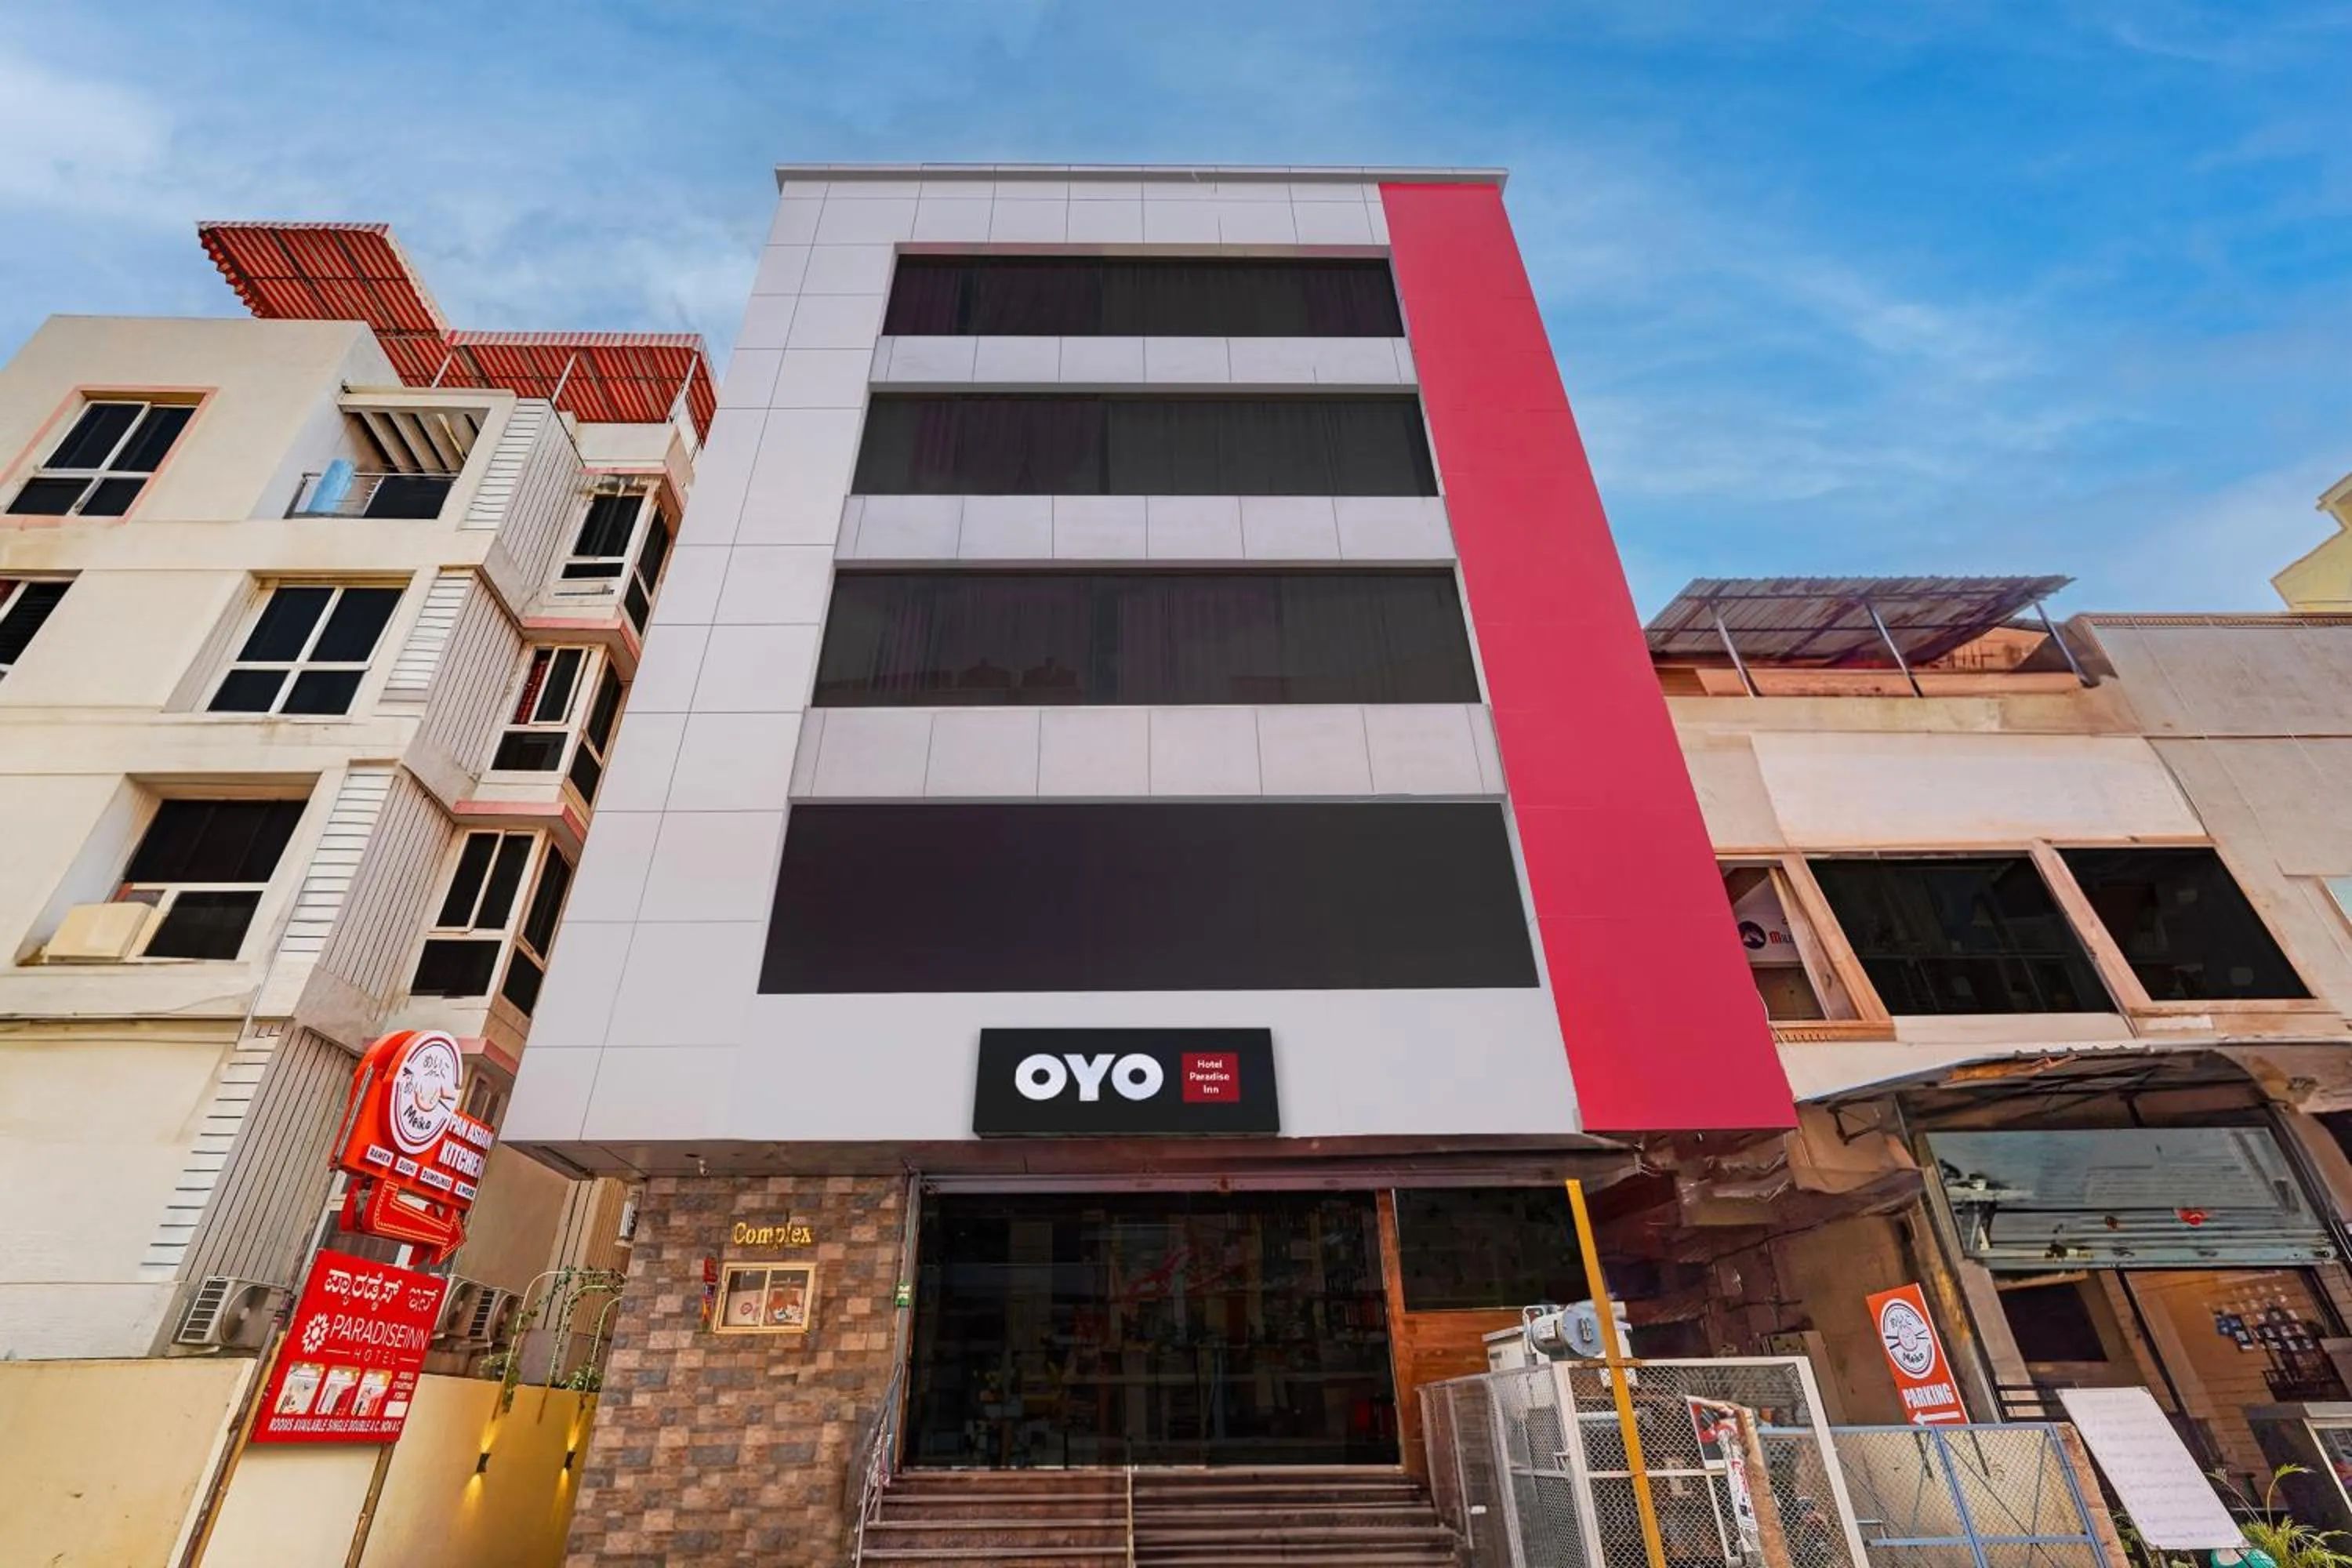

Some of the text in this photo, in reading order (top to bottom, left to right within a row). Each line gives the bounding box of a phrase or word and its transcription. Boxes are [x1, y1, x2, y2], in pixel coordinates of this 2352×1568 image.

[1197, 1059, 1222, 1069] Hotel
[1014, 1053, 1163, 1102] OYO
[1189, 1071, 1230, 1081] Paradise
[1203, 1084, 1219, 1094] Inn
[404, 1105, 432, 1130] Meiko
[733, 1221, 812, 1250] Complex
[354, 1348, 396, 1365] HOTEL
[1902, 1382, 1955, 1409] PARKING
